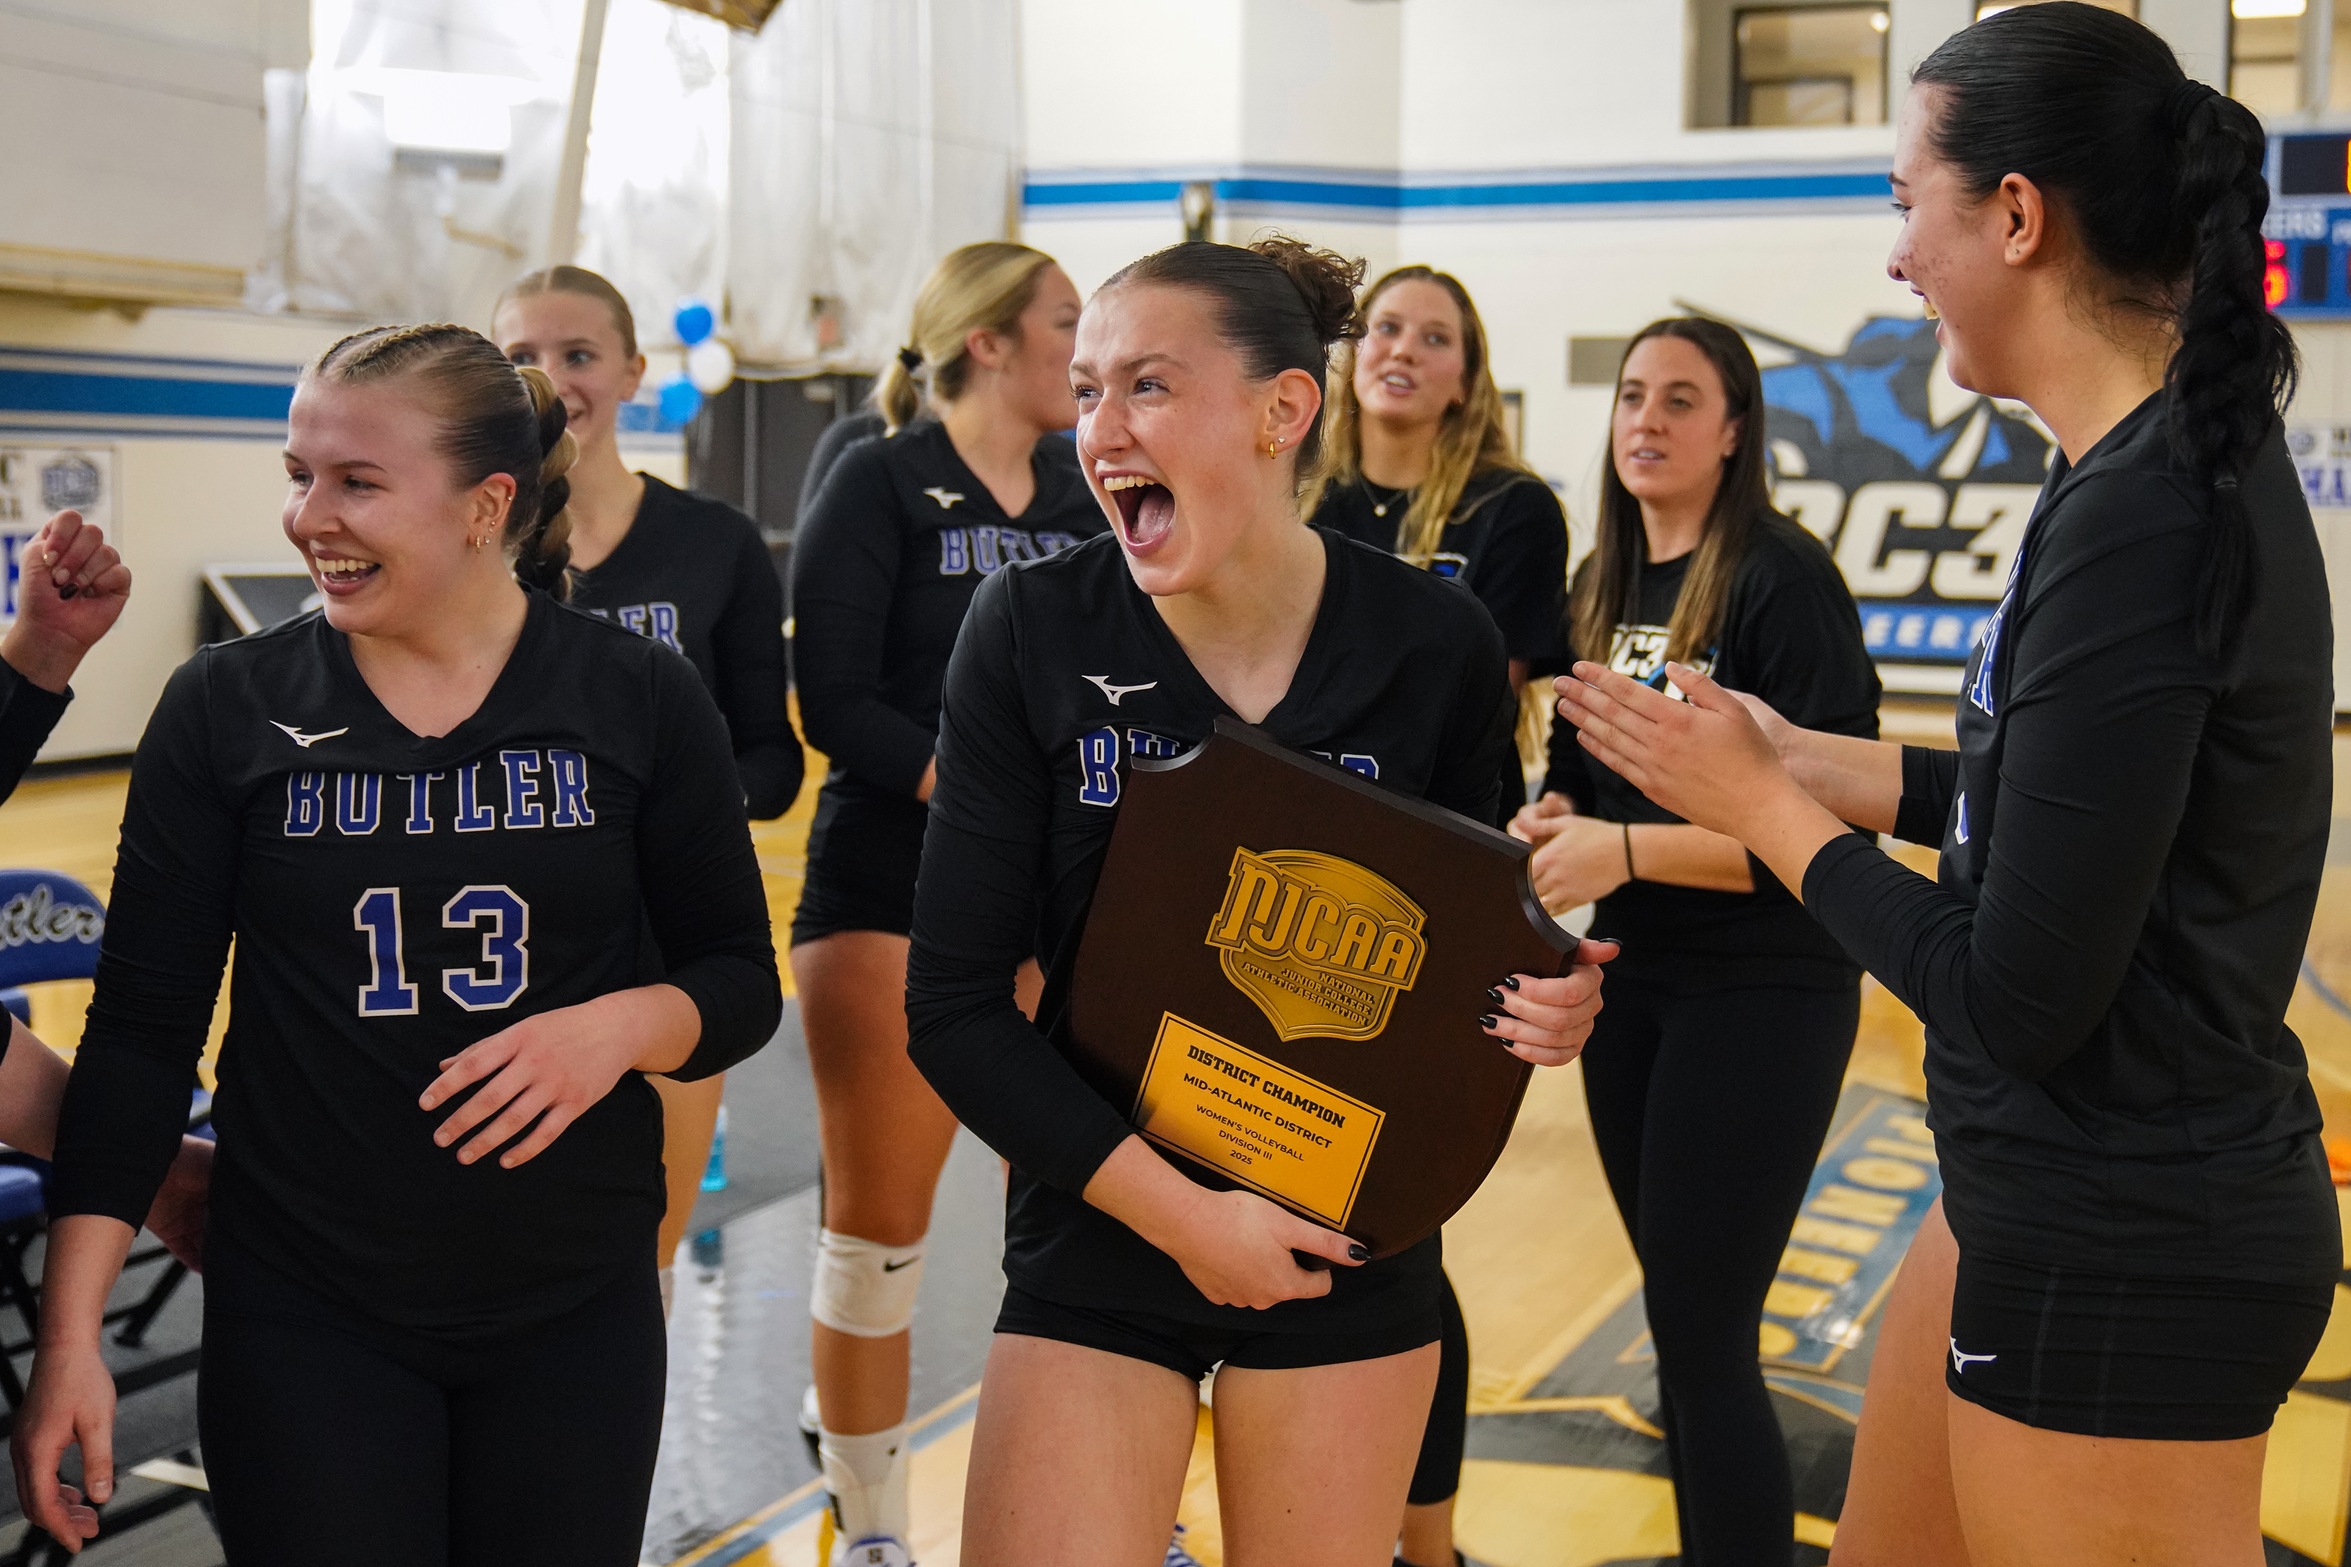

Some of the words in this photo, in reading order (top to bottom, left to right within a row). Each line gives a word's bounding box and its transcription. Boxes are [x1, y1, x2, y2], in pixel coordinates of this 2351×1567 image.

[284, 749, 595, 837] BUTLER
[0, 883, 106, 950] tler
[1219, 862, 1416, 980] NJCAA
[353, 885, 529, 1017] 13
[1243, 962, 1296, 992] ATHLETIC
[1296, 987, 1369, 1027] ASSOCIATION
[1282, 968, 1322, 993] JUNIOR
[1324, 987, 1371, 1016] COLLEGE
[1320, 973, 1375, 1004] NATIONAL
[1183, 1073, 1271, 1121] MID-ATLANTIC
[1275, 1117, 1333, 1149] DISTRICT
[1187, 1045, 1260, 1087] DISTRICT
[1262, 1080, 1346, 1129] CHAMPION
[1196, 1104, 1243, 1131] WOMEN'S
[1245, 1127, 1304, 1161] VOLLEYBALL
[1218, 1129, 1262, 1155] DIVISION
[1263, 1151, 1273, 1160] III
[1229, 1149, 1253, 1165] 2025
